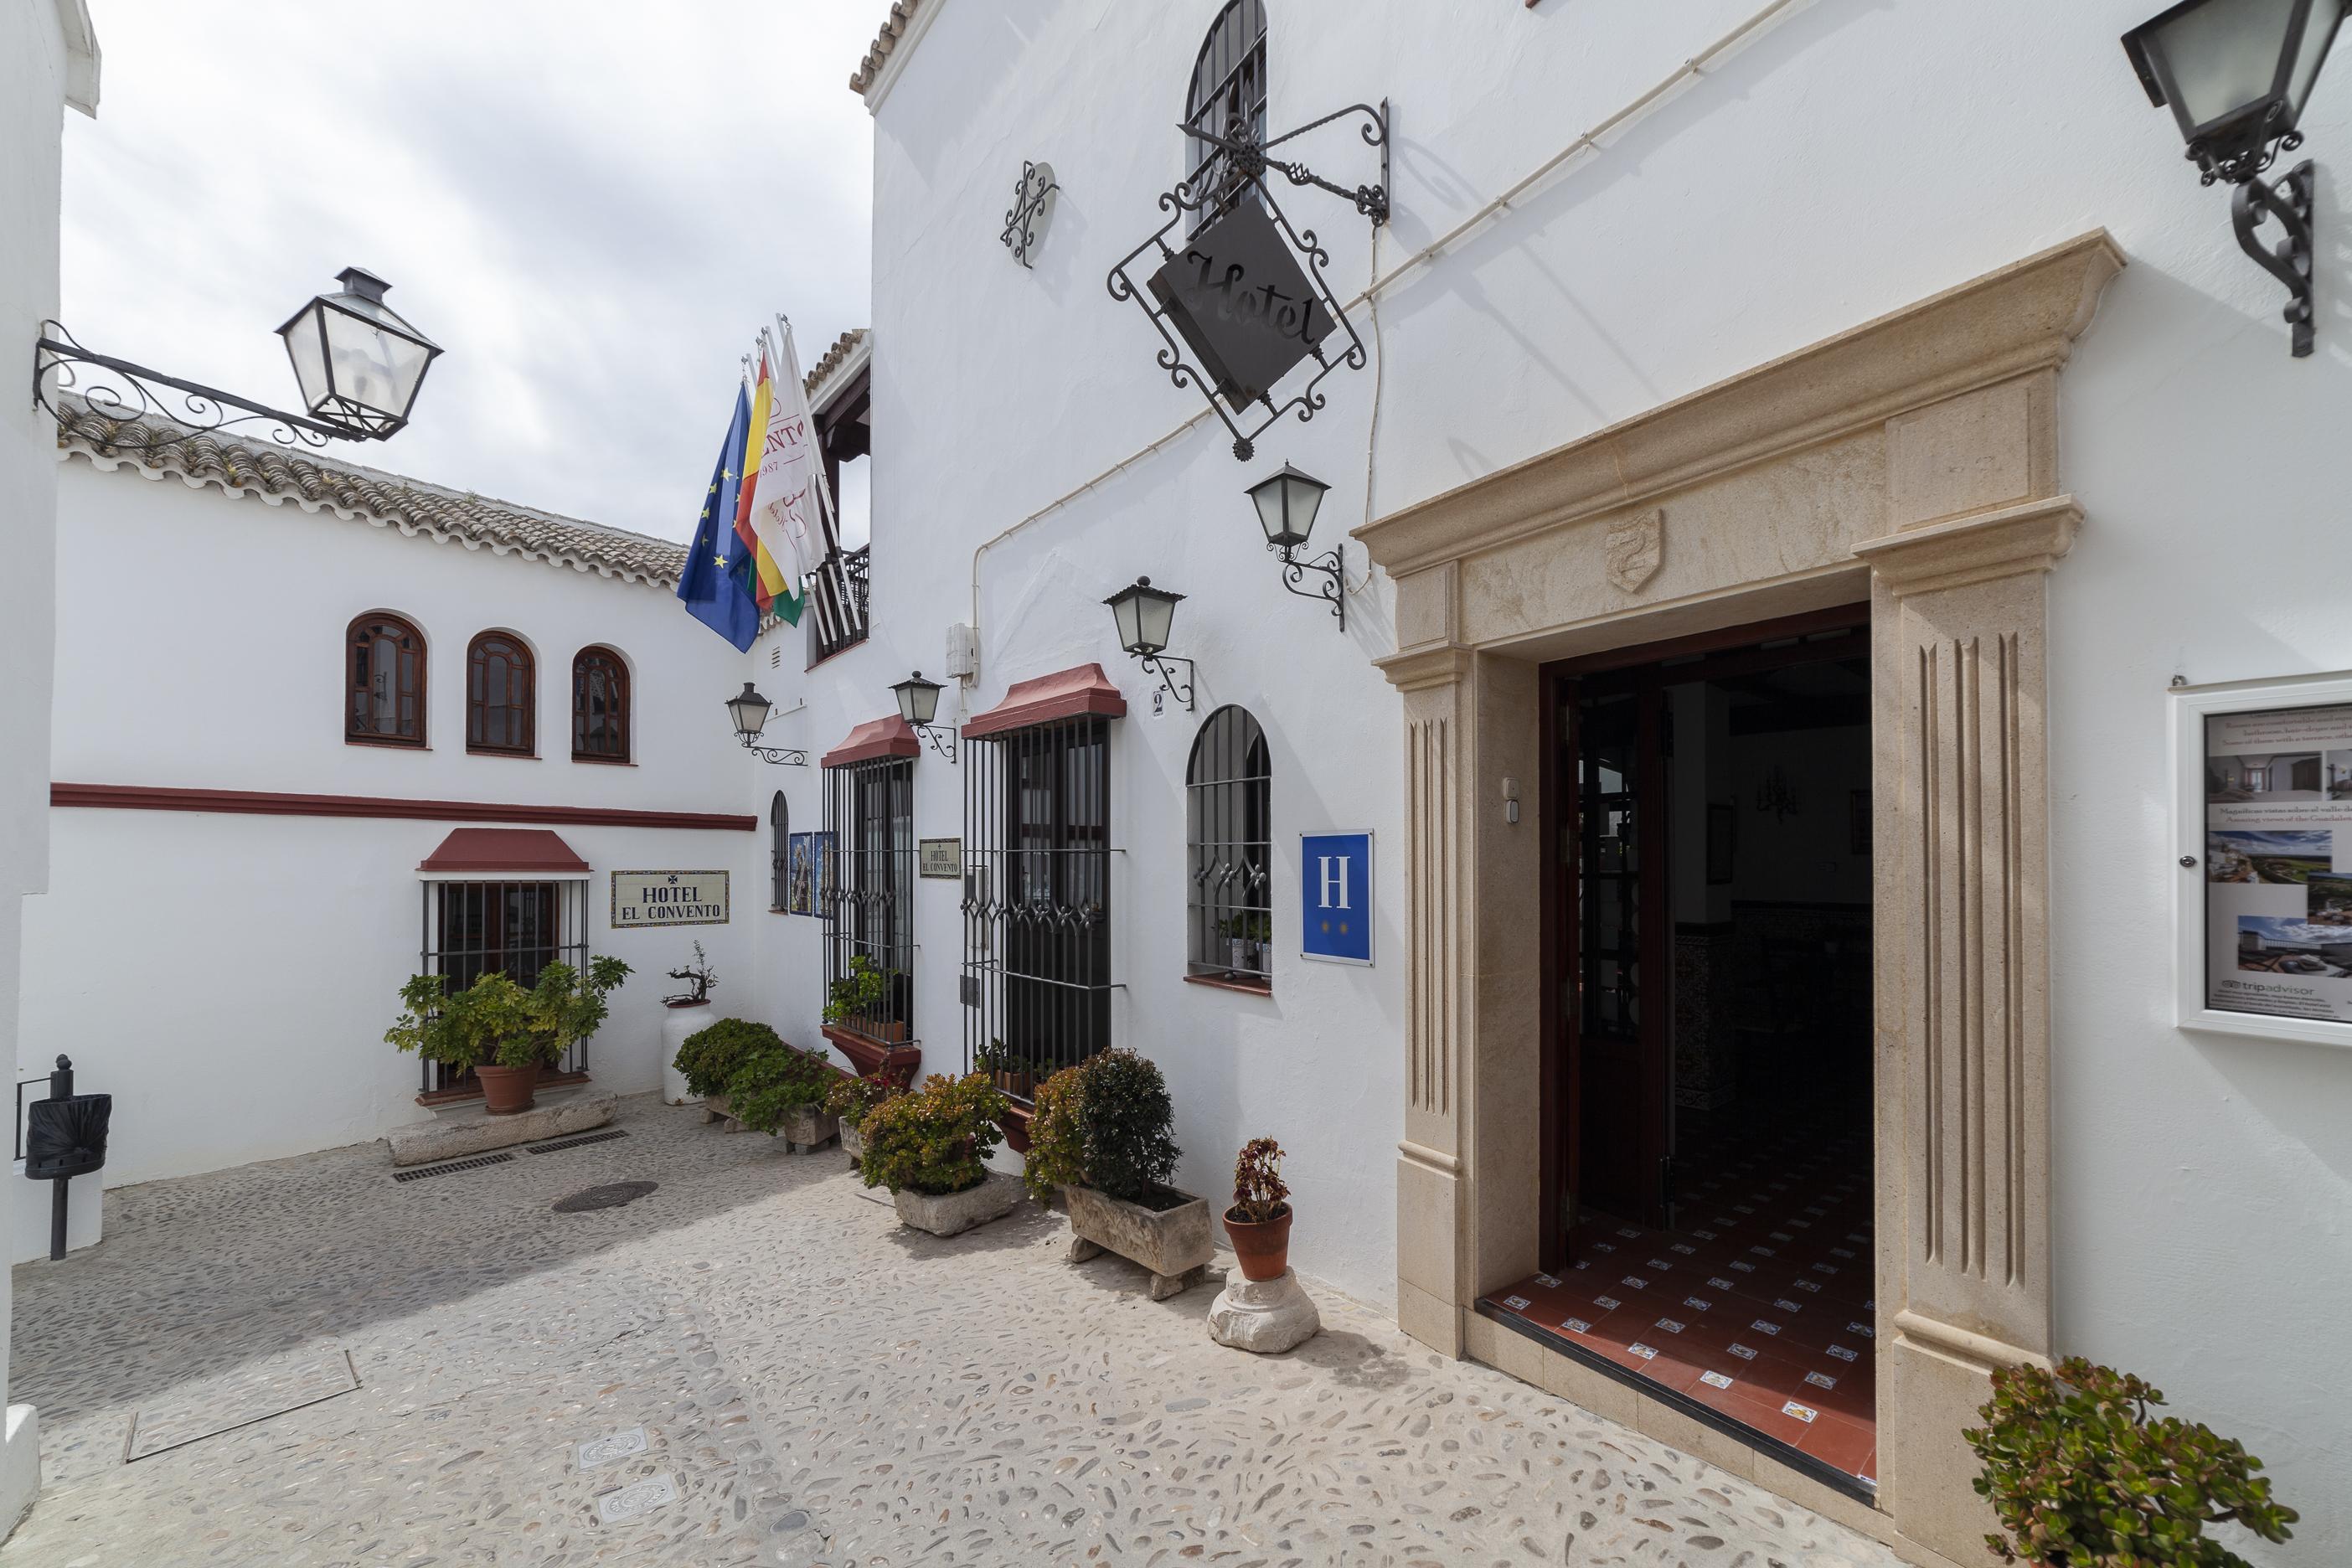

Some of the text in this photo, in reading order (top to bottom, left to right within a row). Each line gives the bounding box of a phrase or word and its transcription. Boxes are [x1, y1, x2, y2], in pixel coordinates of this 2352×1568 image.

[1184, 250, 1316, 344] Hotel
[1154, 694, 1162, 712] 2
[931, 850, 948, 861] HOTEL
[930, 863, 957, 872] CONVENTO
[1318, 856, 1351, 909] H
[642, 886, 702, 903] HOTEL
[622, 904, 720, 920] EL CONVENTO
[2243, 982, 2316, 995] tripadvisor
